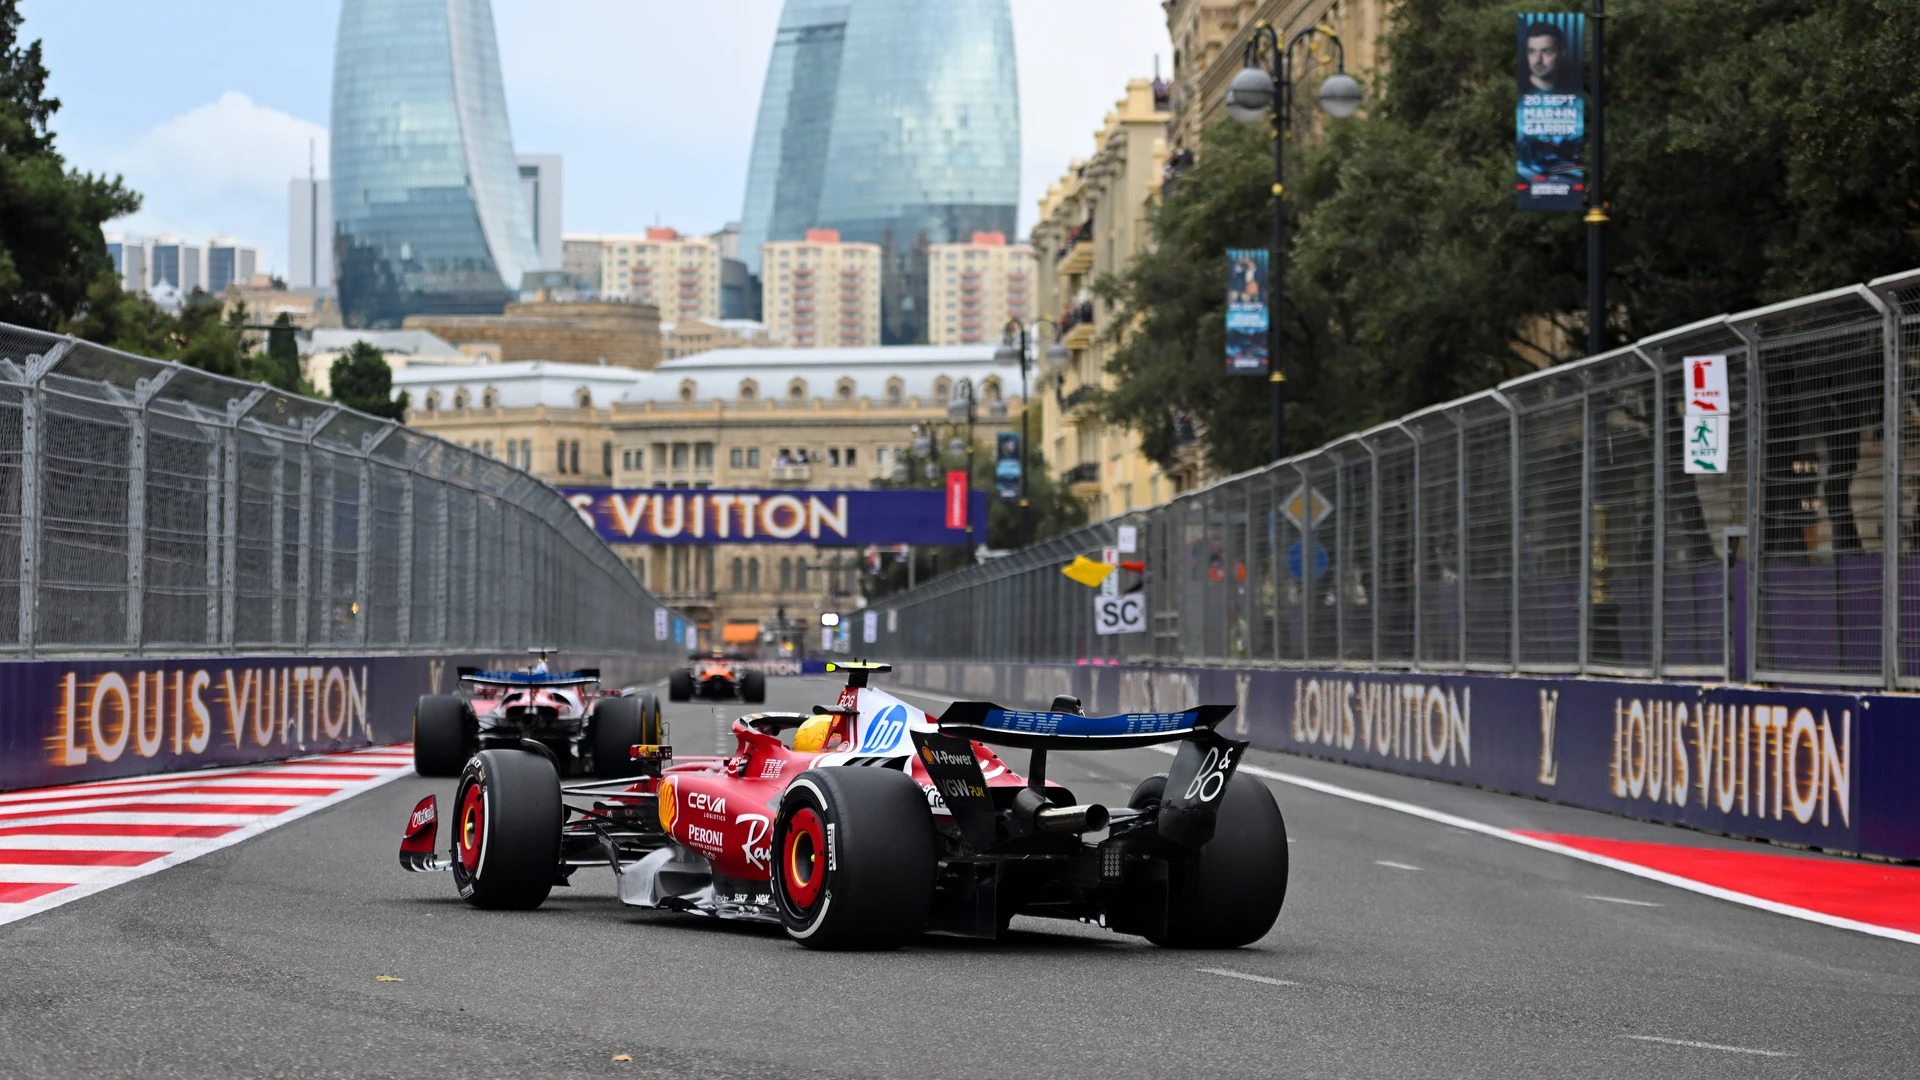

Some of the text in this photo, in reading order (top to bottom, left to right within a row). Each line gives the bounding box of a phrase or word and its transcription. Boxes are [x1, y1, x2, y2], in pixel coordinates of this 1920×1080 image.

[1523, 94, 1576, 106] 20 SEPT
[1523, 123, 1576, 135] GARRIX
[611, 494, 849, 539] VUITTON
[1103, 601, 1139, 626] SC
[65, 666, 368, 766] LOUIS VUITTON
[1002, 711, 1063, 734] IBM
[1126, 713, 1186, 733] IBM
[1294, 677, 1355, 750] LOUIS
[1359, 681, 1471, 767] VUITTON
[931, 749, 972, 765] V-Power
[1614, 698, 1851, 829] LOUIS VUITTON
[760, 758, 788, 779] IBM
[936, 779, 970, 797] VGW
[703, 812, 726, 821] LOGISTICS
[688, 823, 723, 846] PERONI
[755, 893, 770, 905] NGK
